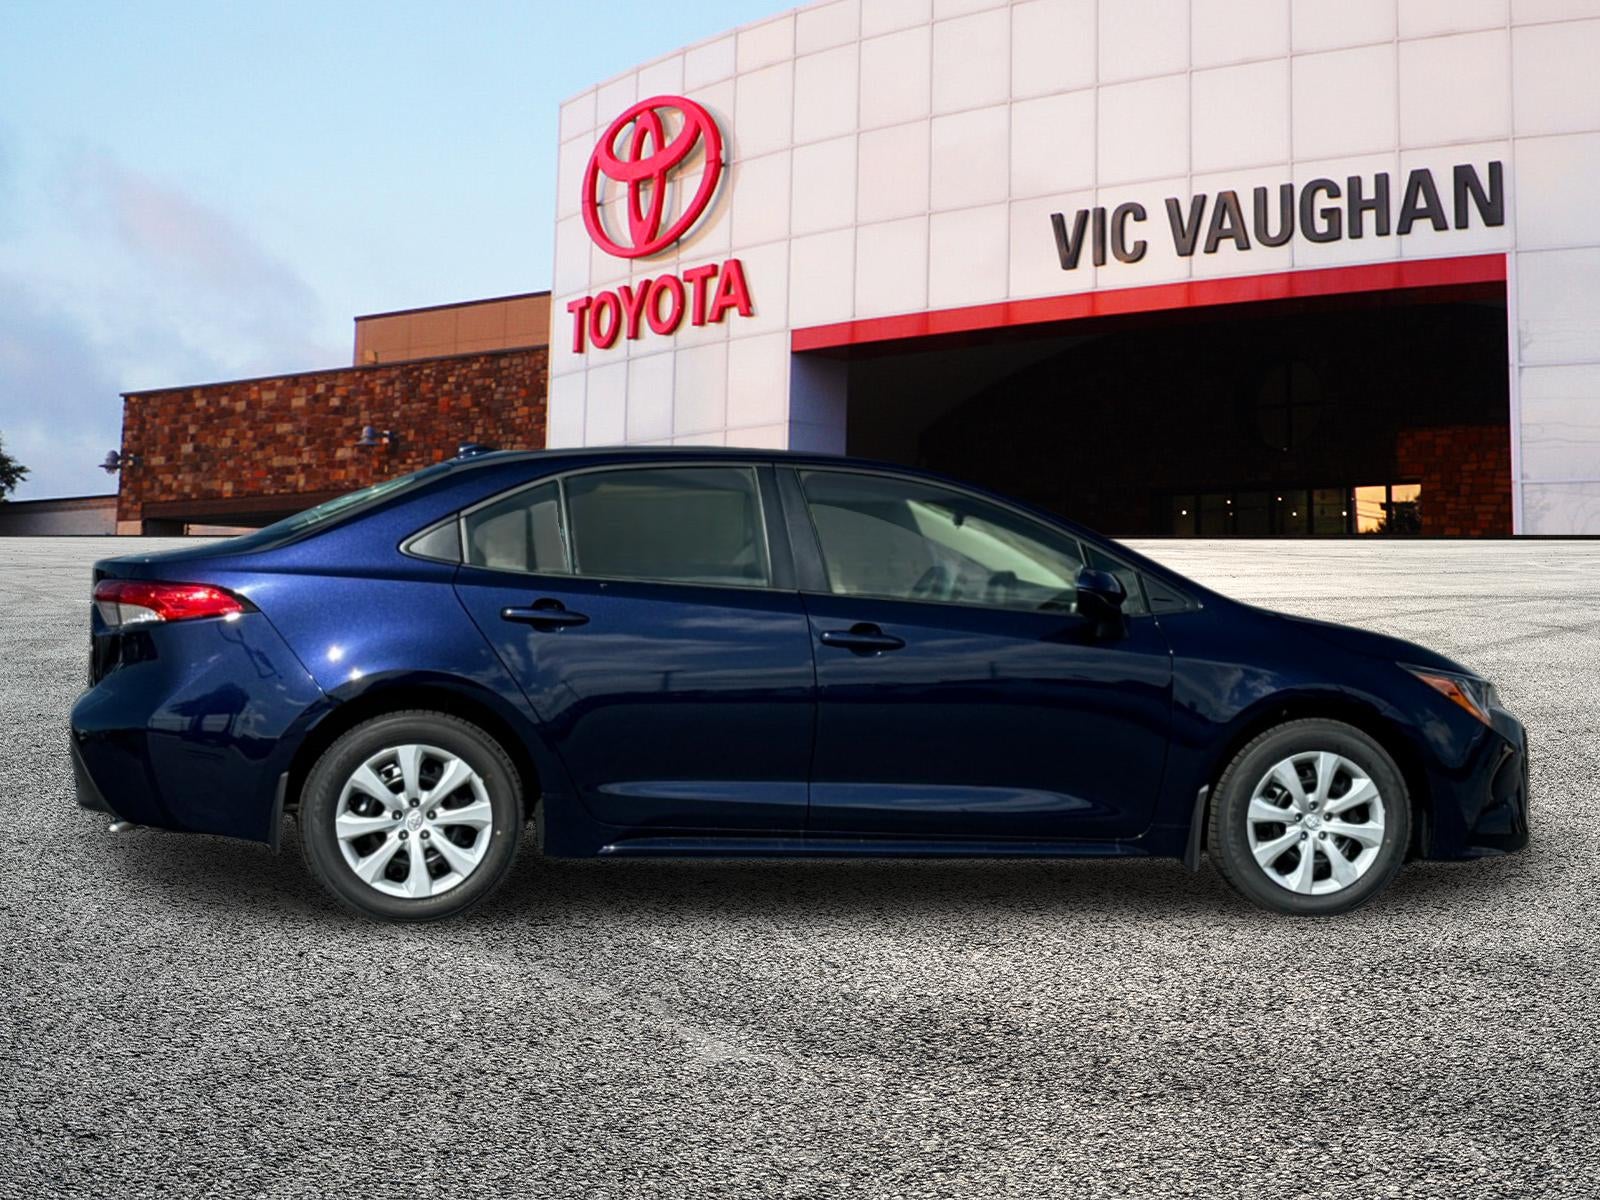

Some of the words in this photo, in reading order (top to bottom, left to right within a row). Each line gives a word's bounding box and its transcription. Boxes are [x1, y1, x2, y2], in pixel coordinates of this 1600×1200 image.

[1050, 201, 1147, 270] VIC
[1165, 161, 1504, 257] VAUGHAN
[567, 258, 754, 354] TOYOTA
